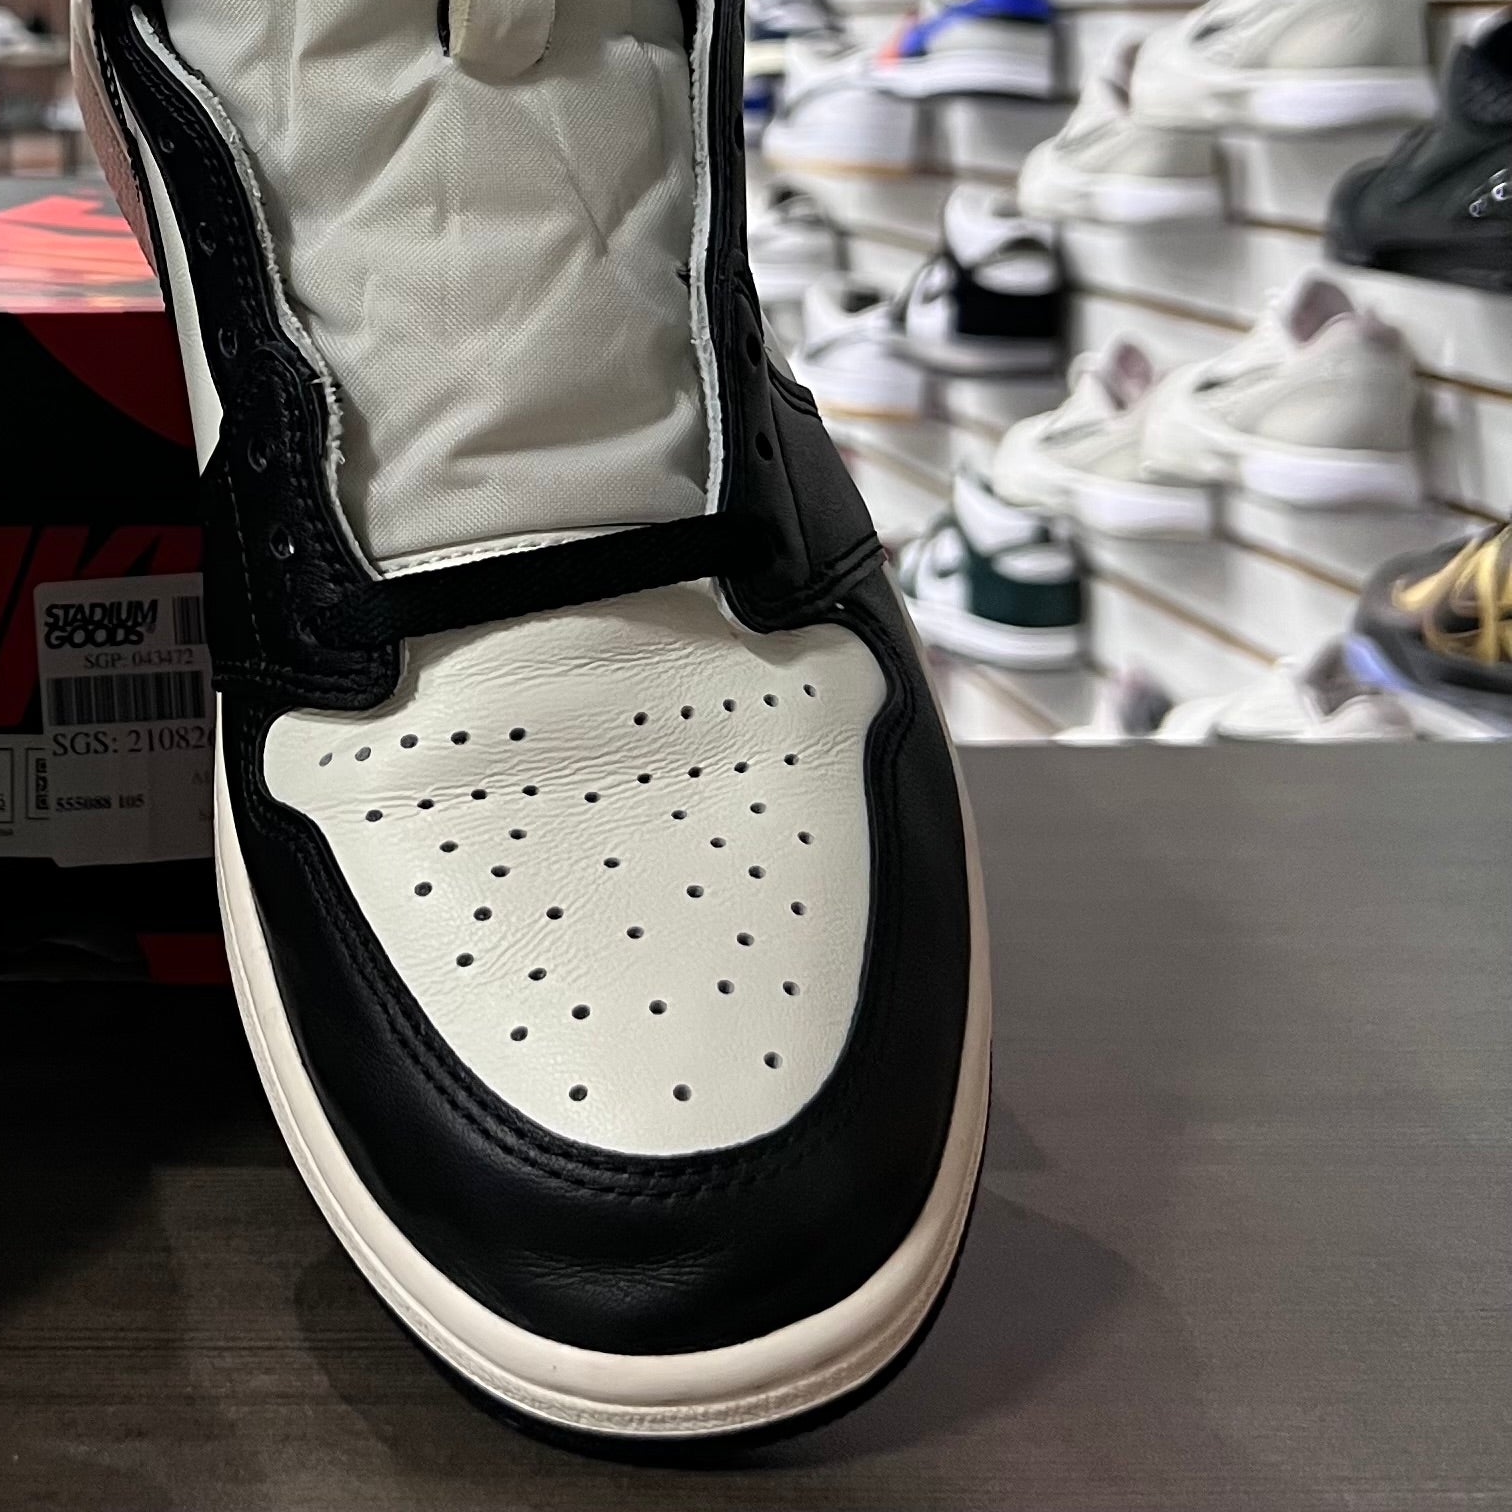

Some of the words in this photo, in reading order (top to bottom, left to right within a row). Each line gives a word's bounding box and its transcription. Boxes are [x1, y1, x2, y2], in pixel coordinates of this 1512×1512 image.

[45, 599, 159, 627] STADIUM
[44, 623, 144, 649] GOODS
[132, 648, 194, 667] 043472
[52, 731, 119, 757] SGS:
